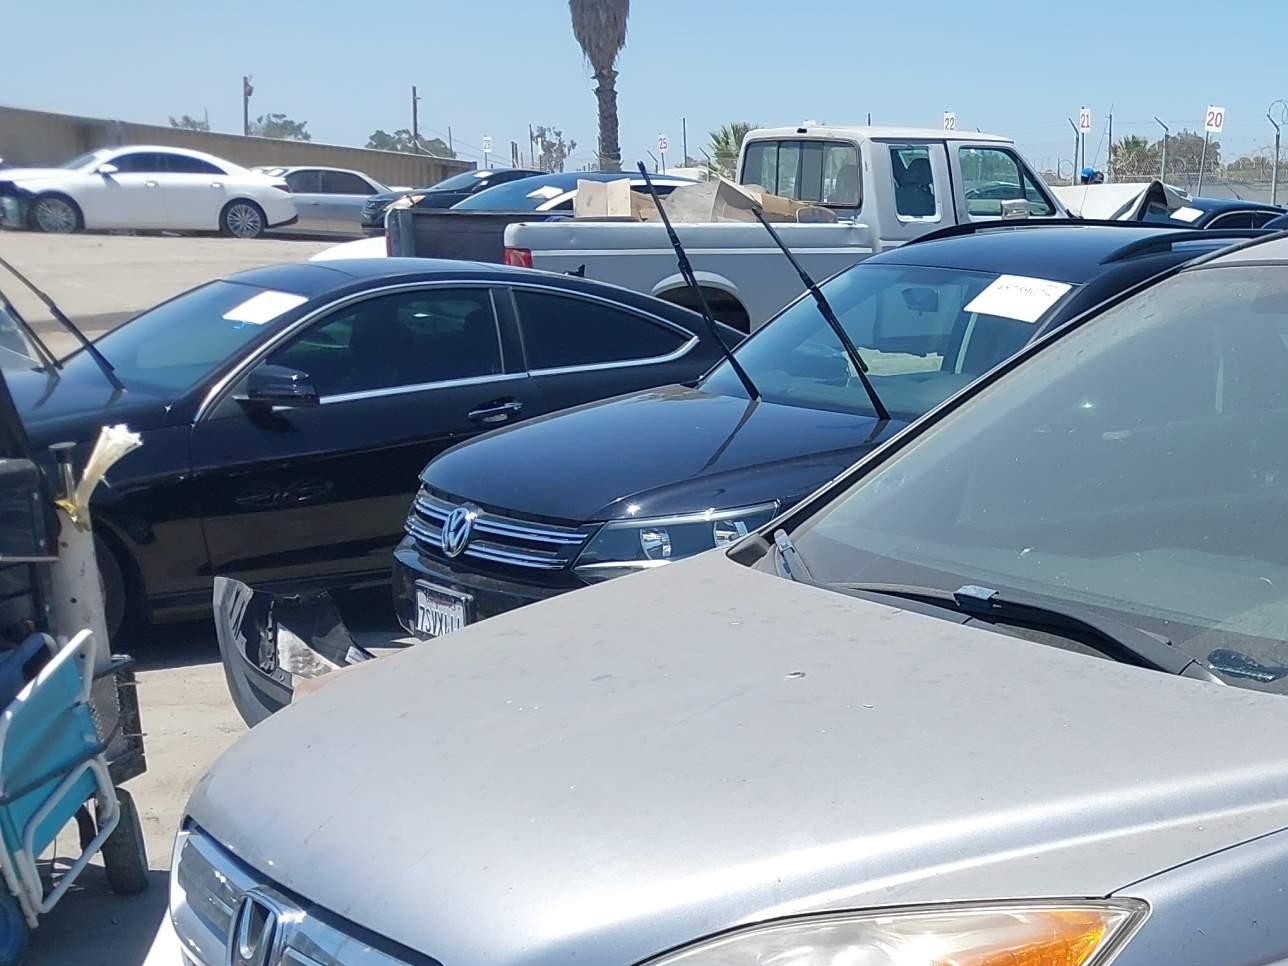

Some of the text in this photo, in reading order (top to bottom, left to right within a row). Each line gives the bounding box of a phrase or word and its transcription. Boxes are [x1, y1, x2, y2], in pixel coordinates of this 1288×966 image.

[944, 117, 955, 131] 22
[1080, 113, 1090, 129] 21
[1206, 111, 1223, 128] 20
